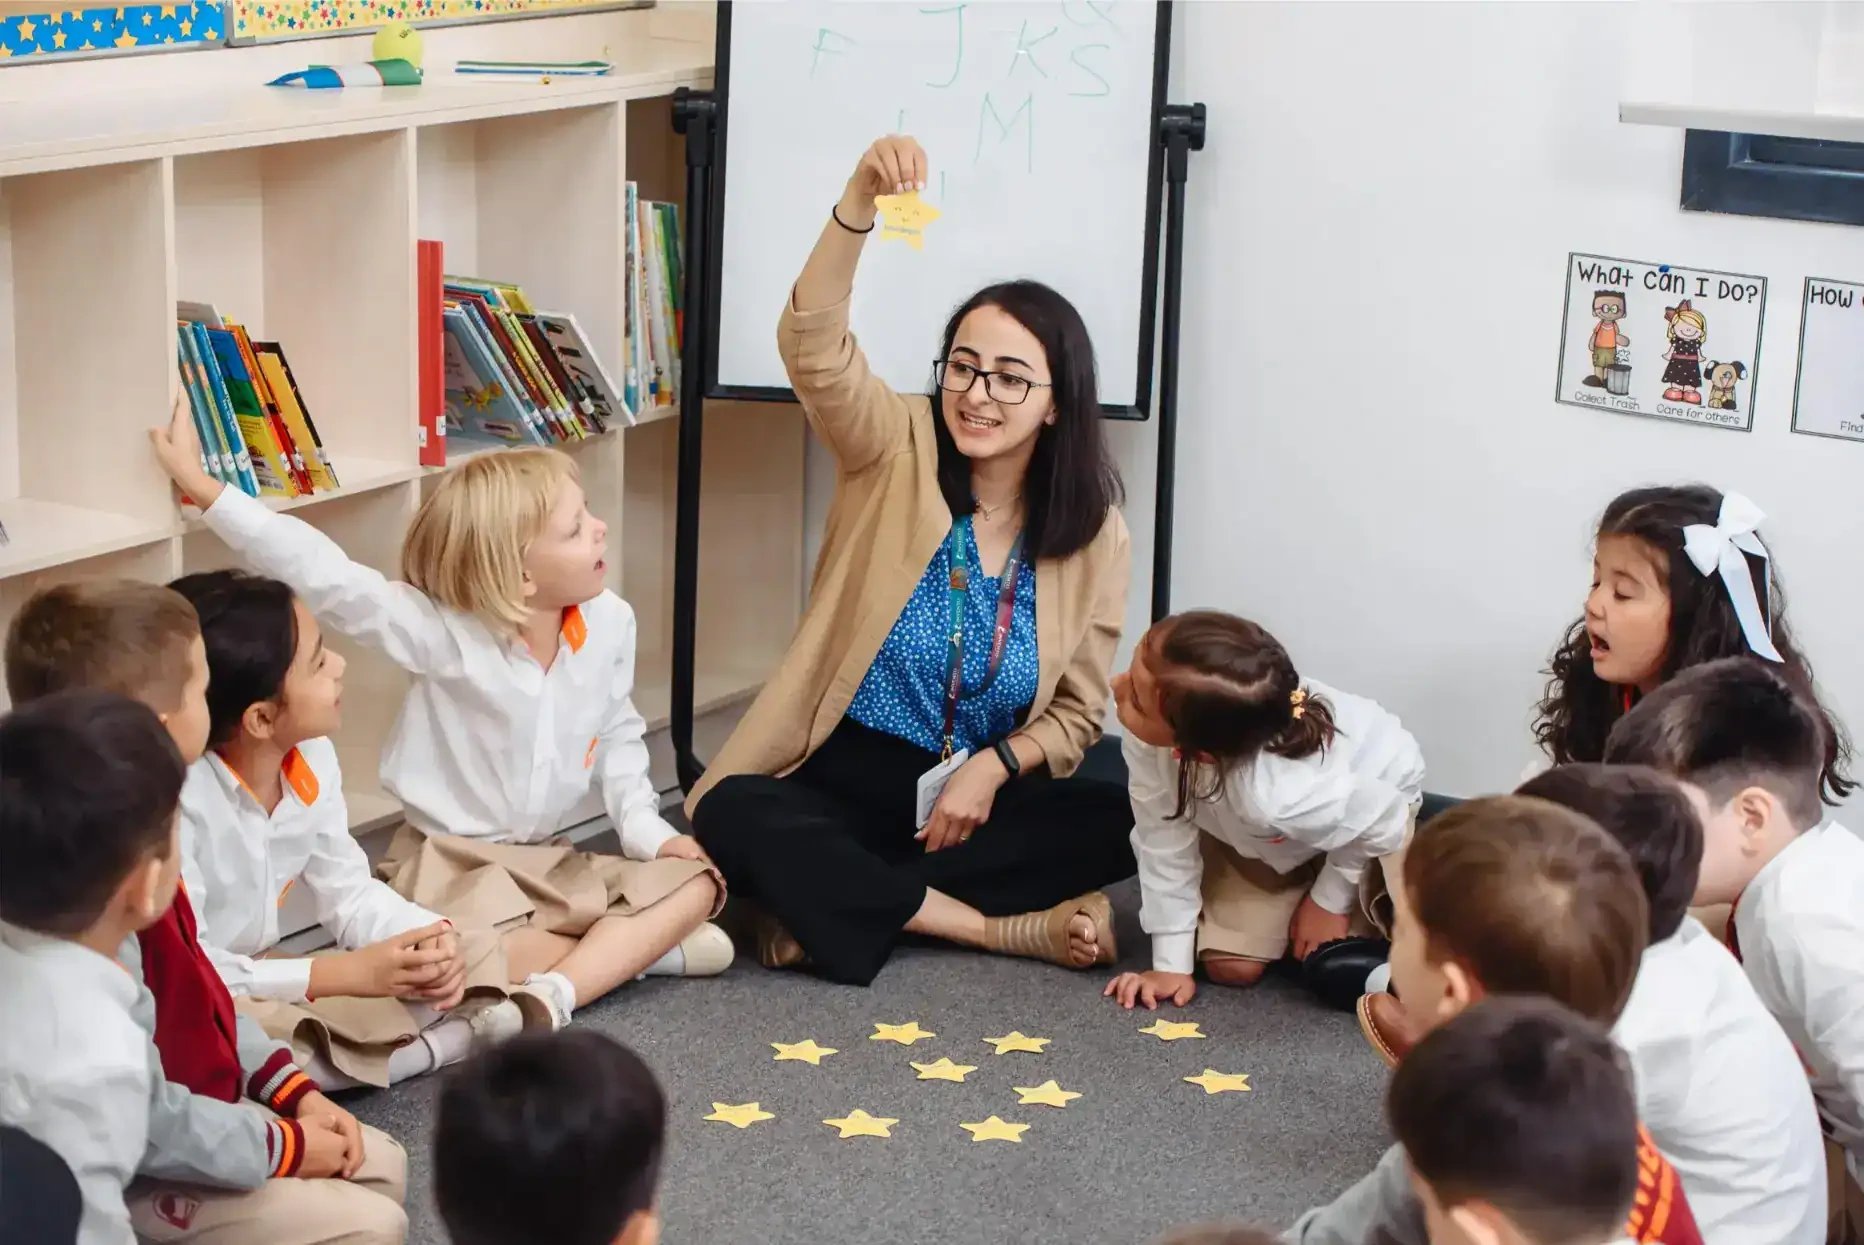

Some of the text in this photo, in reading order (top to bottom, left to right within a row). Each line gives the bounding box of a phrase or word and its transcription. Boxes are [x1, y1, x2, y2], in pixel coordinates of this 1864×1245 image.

[808, 27, 858, 80] F
[918, 3, 967, 88] J
[1008, 18, 1059, 79] K
[1067, 43, 1111, 97] S
[973, 91, 1033, 174] M
[1578, 261, 1634, 288] What
[1643, 270, 1685, 295] Can
[1694, 277, 1709, 298] I
[1610, 396, 1640, 411] Trash
[1656, 403, 1741, 425] Care for others
